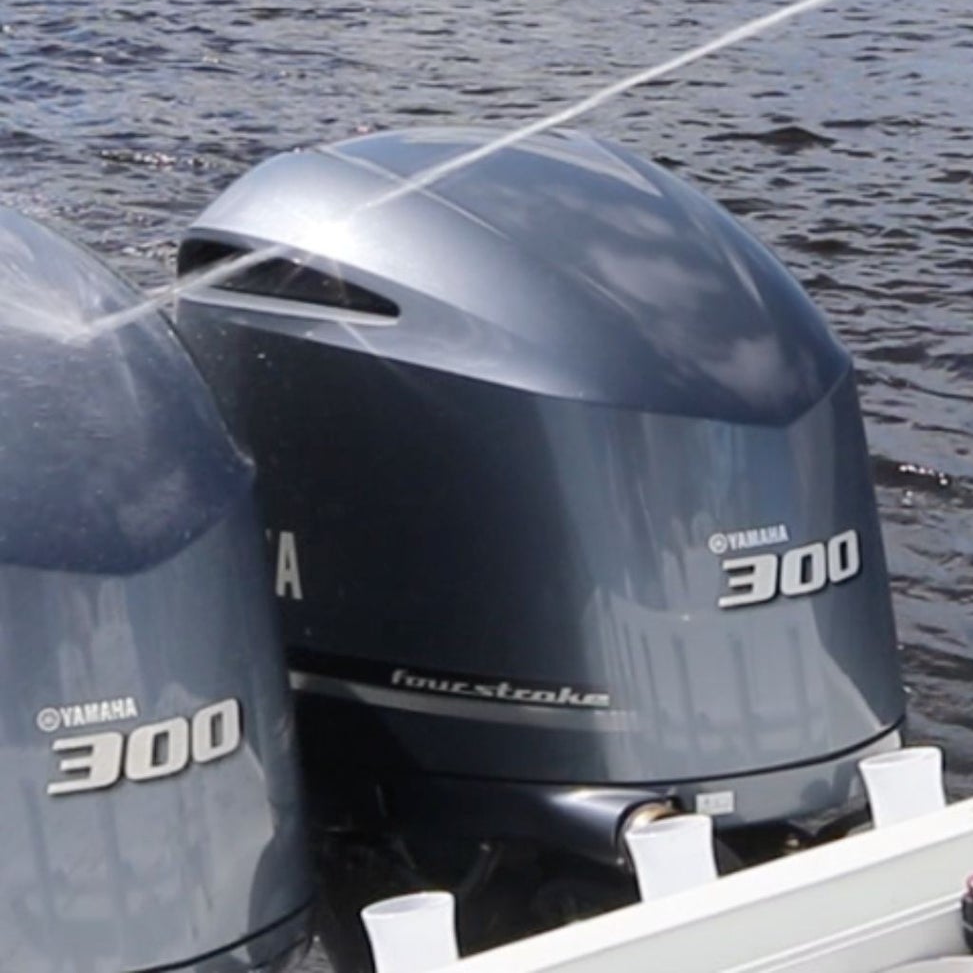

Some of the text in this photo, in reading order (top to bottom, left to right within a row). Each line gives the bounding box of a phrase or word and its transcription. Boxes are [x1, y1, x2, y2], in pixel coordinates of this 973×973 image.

[727, 524, 789, 550] YAMAHA
[265, 529, 303, 600] A
[718, 529, 860, 608] 300
[60, 697, 138, 727] YAMAHA
[391, 669, 610, 707] fourstroke
[47, 698, 241, 795] 300
